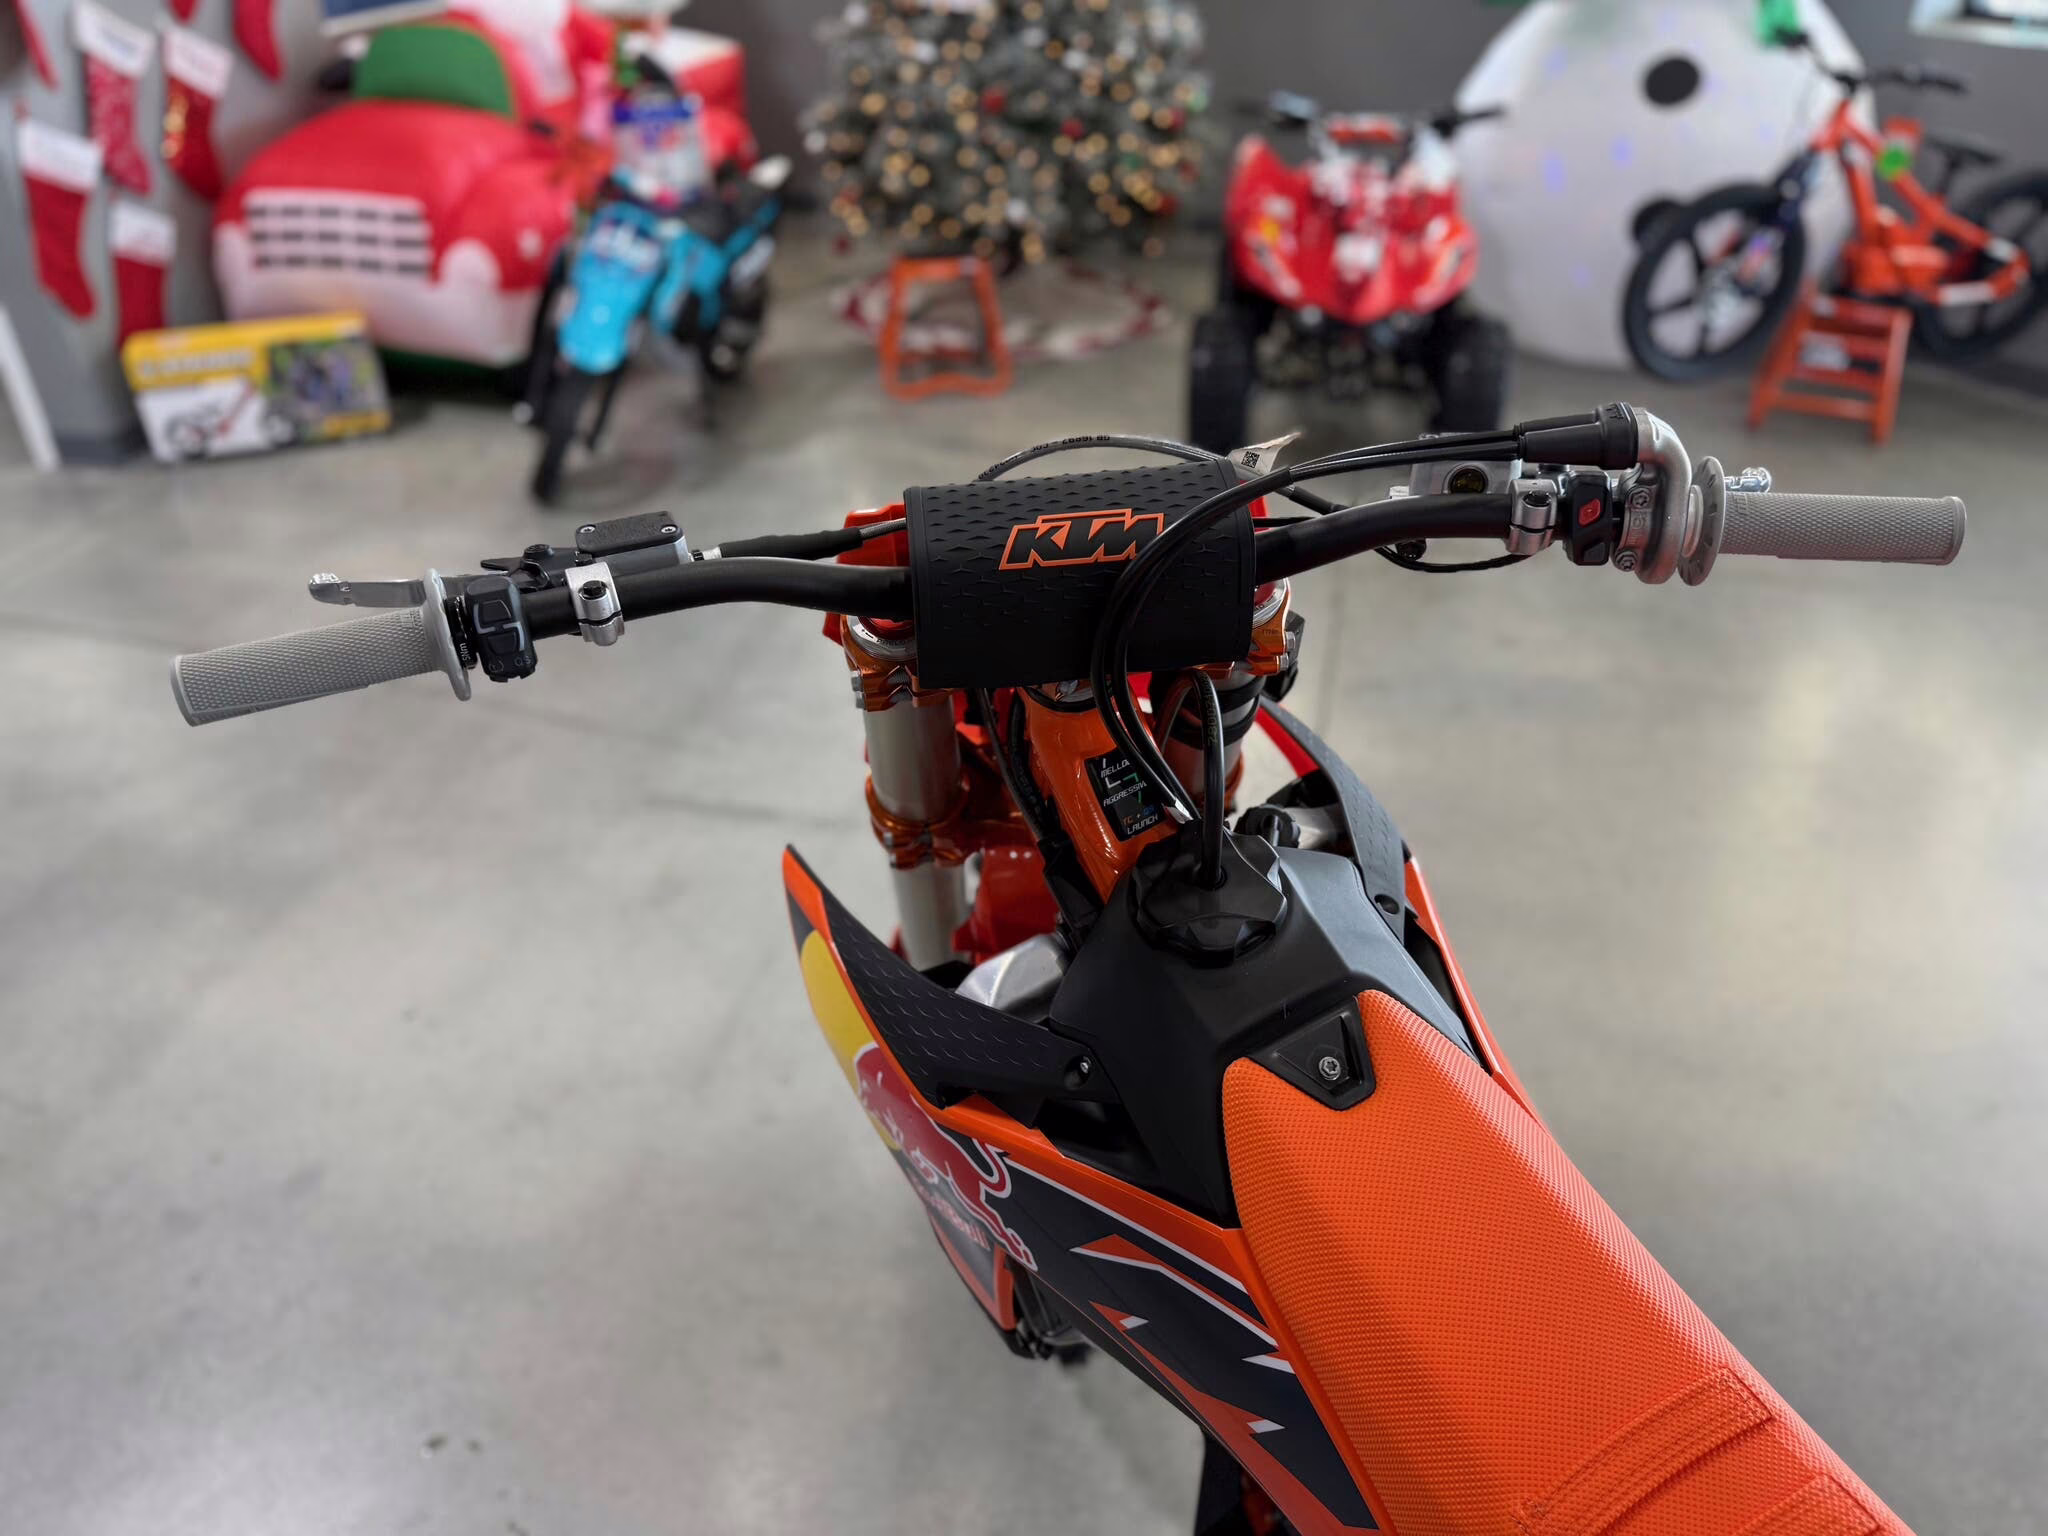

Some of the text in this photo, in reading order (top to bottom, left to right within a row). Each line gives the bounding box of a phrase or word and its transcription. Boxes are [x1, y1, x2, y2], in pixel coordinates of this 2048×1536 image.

[998, 508, 1164, 571] KTM
[1101, 759, 1130, 778] MELLO
[1103, 780, 1148, 807] AGGRESSIV
[1127, 814, 1158, 835] LAUNCH
